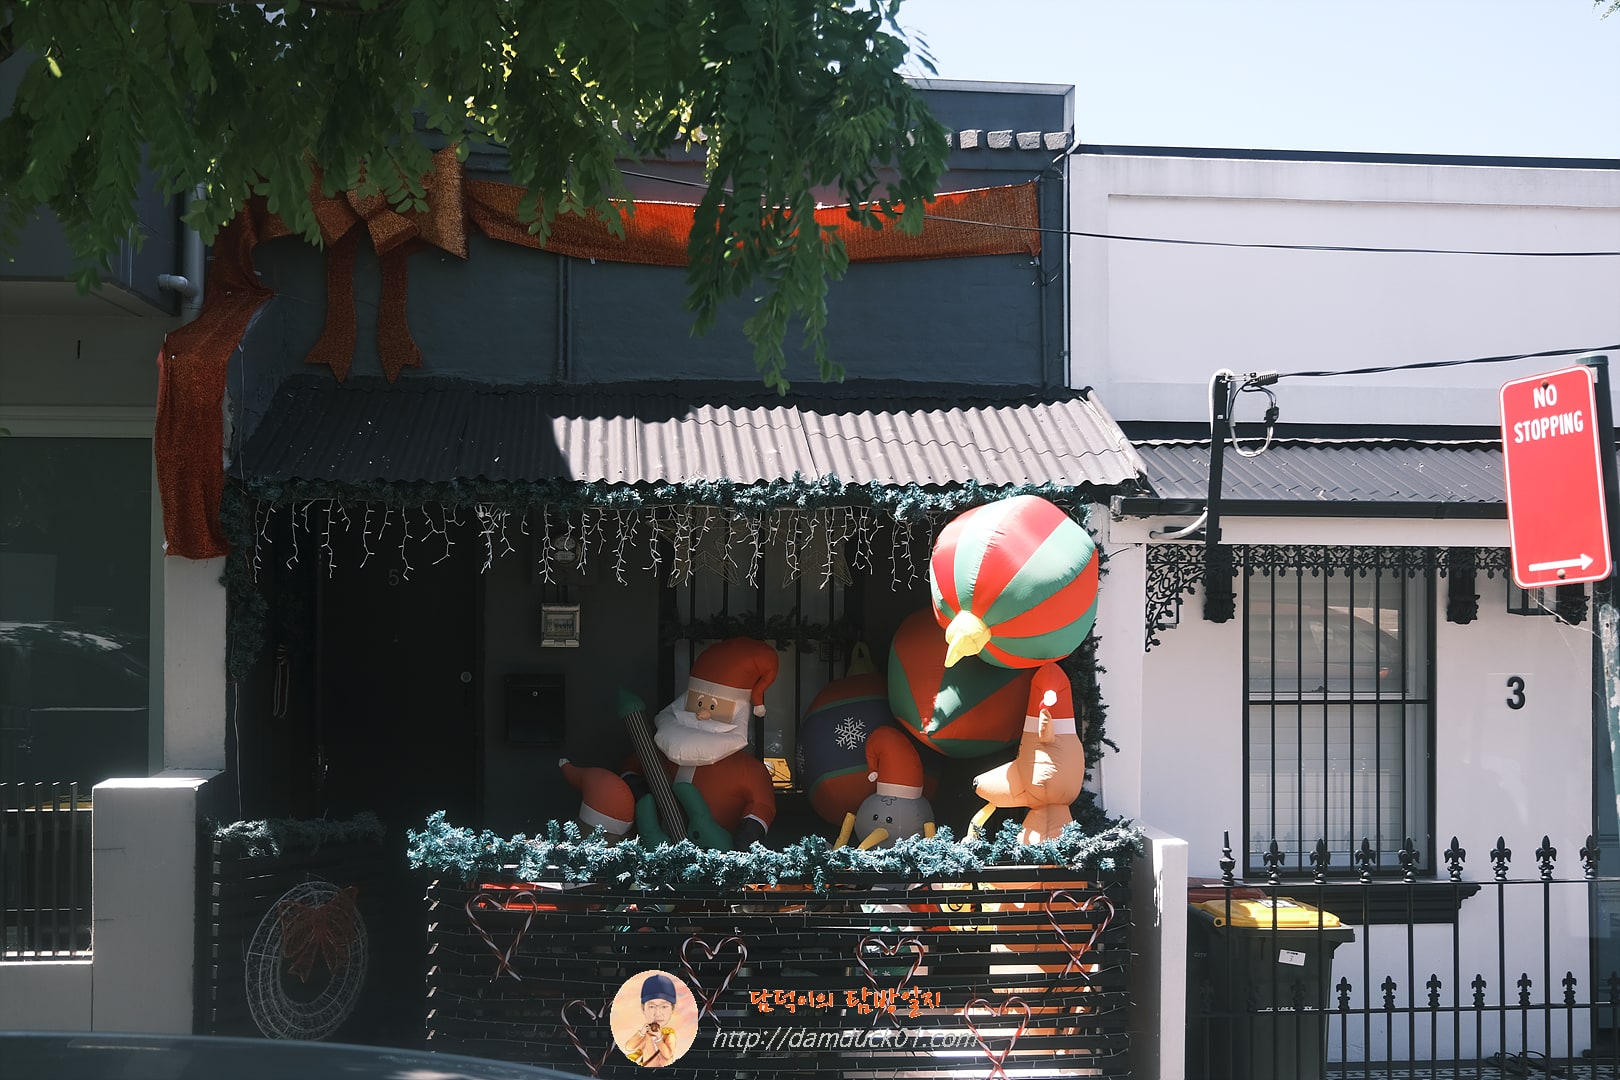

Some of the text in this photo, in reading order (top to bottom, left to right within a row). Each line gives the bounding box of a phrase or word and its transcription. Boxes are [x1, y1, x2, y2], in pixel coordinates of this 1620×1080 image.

[1533, 384, 1557, 409] NO
[1514, 410, 1584, 444] STOPPING
[388, 568, 400, 586] 5
[1506, 676, 1526, 710] 3
